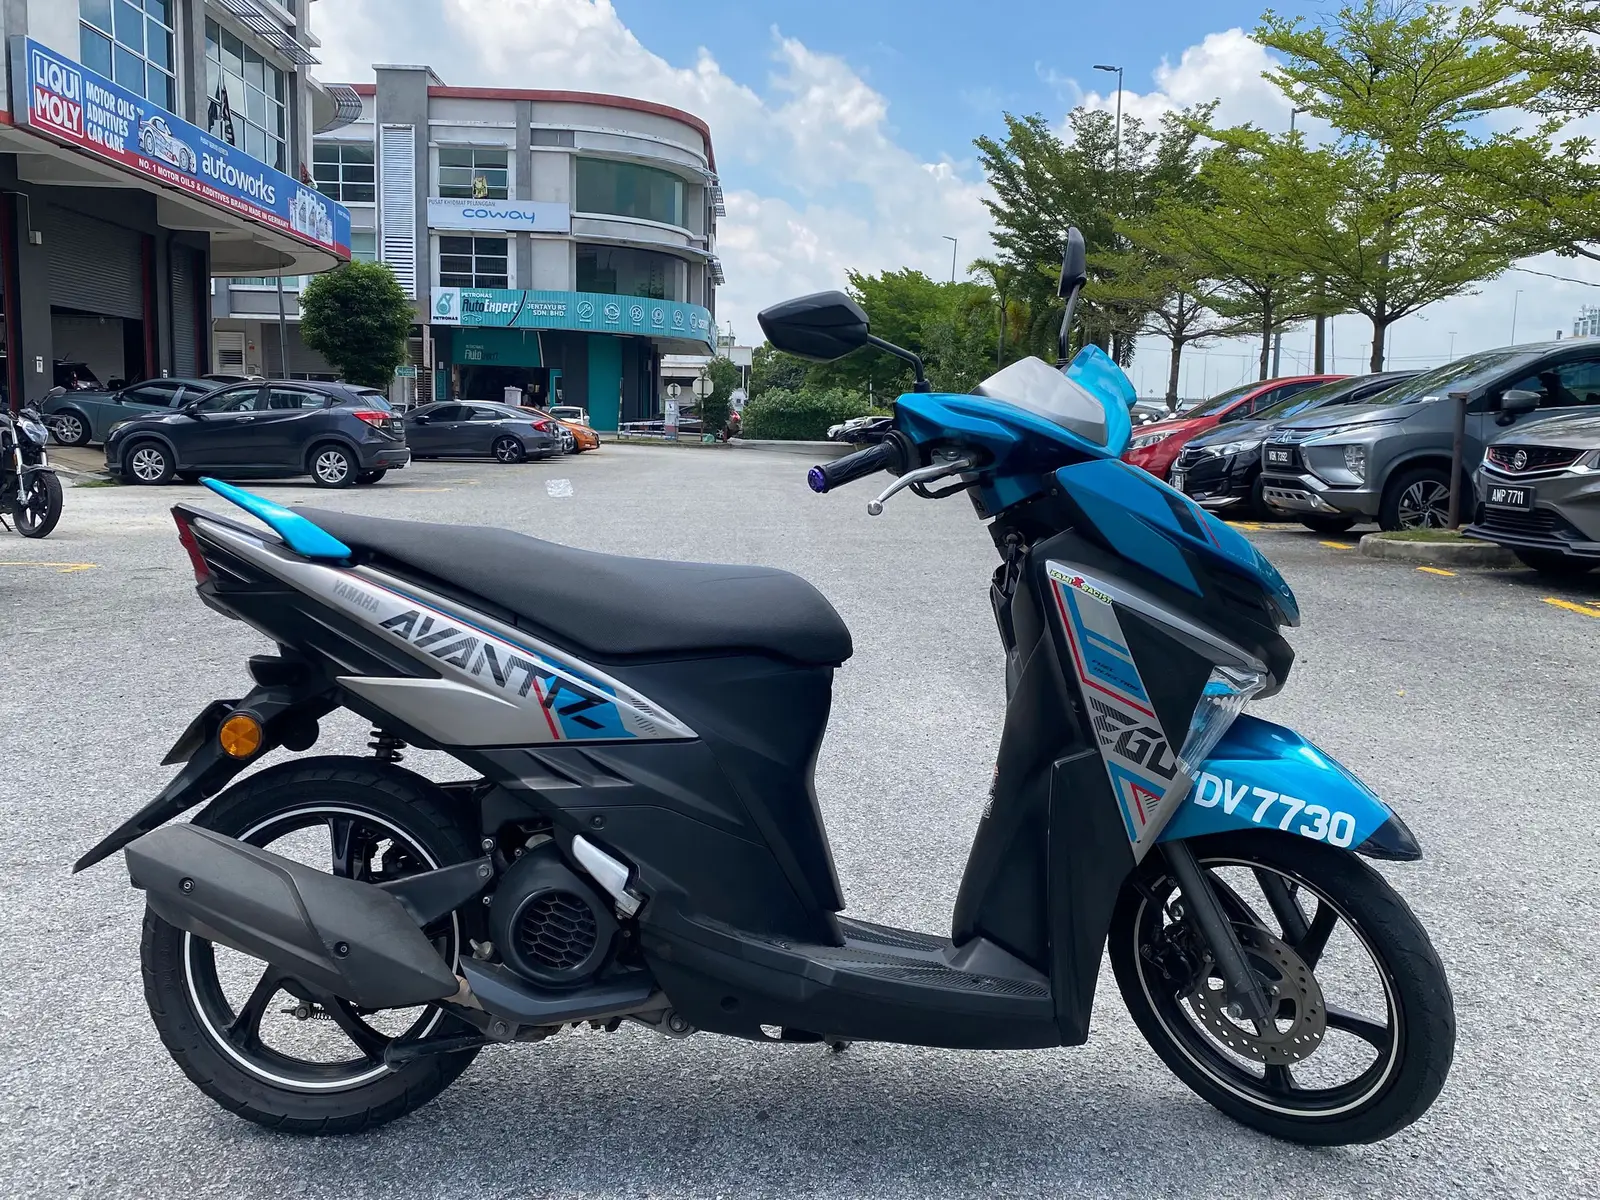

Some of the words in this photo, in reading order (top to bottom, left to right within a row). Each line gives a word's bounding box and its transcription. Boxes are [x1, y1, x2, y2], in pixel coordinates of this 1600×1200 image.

[35, 55, 80, 102] LIQUI
[36, 88, 80, 132] MOLY
[86, 80, 116, 113] MOTOR
[117, 97, 135, 121] OILS
[86, 102, 129, 138] ADDITIVES
[87, 122, 104, 146] CAR
[104, 130, 125, 155] CARE
[138, 157, 152, 171] NO.
[152, 164, 156, 172] 1
[157, 165, 180, 183] MOTOR
[180, 176, 195, 190] OILS
[196, 182, 201, 191] &
[201, 185, 230, 205] ADDITIVES
[230, 198, 249, 213] BRAND
[248, 205, 262, 218] MADE
[261, 210, 268, 220] IN
[267, 214, 289, 229] GERMANY
[202, 151, 276, 206] autoworks
[462, 208, 535, 224] coway
[462, 299, 519, 315] AutoExpert
[526, 303, 557, 311] JENTAYU
[1507, 489, 1524, 505] 7711
[333, 579, 380, 613] YAMAHA
[1050, 569, 1072, 585] KAMI
[1081, 585, 1113, 605] RACIST
[379, 609, 611, 731] AVANTIZ
[1091, 659, 1115, 672] FUEL
[1251, 786, 1356, 848] 7730
